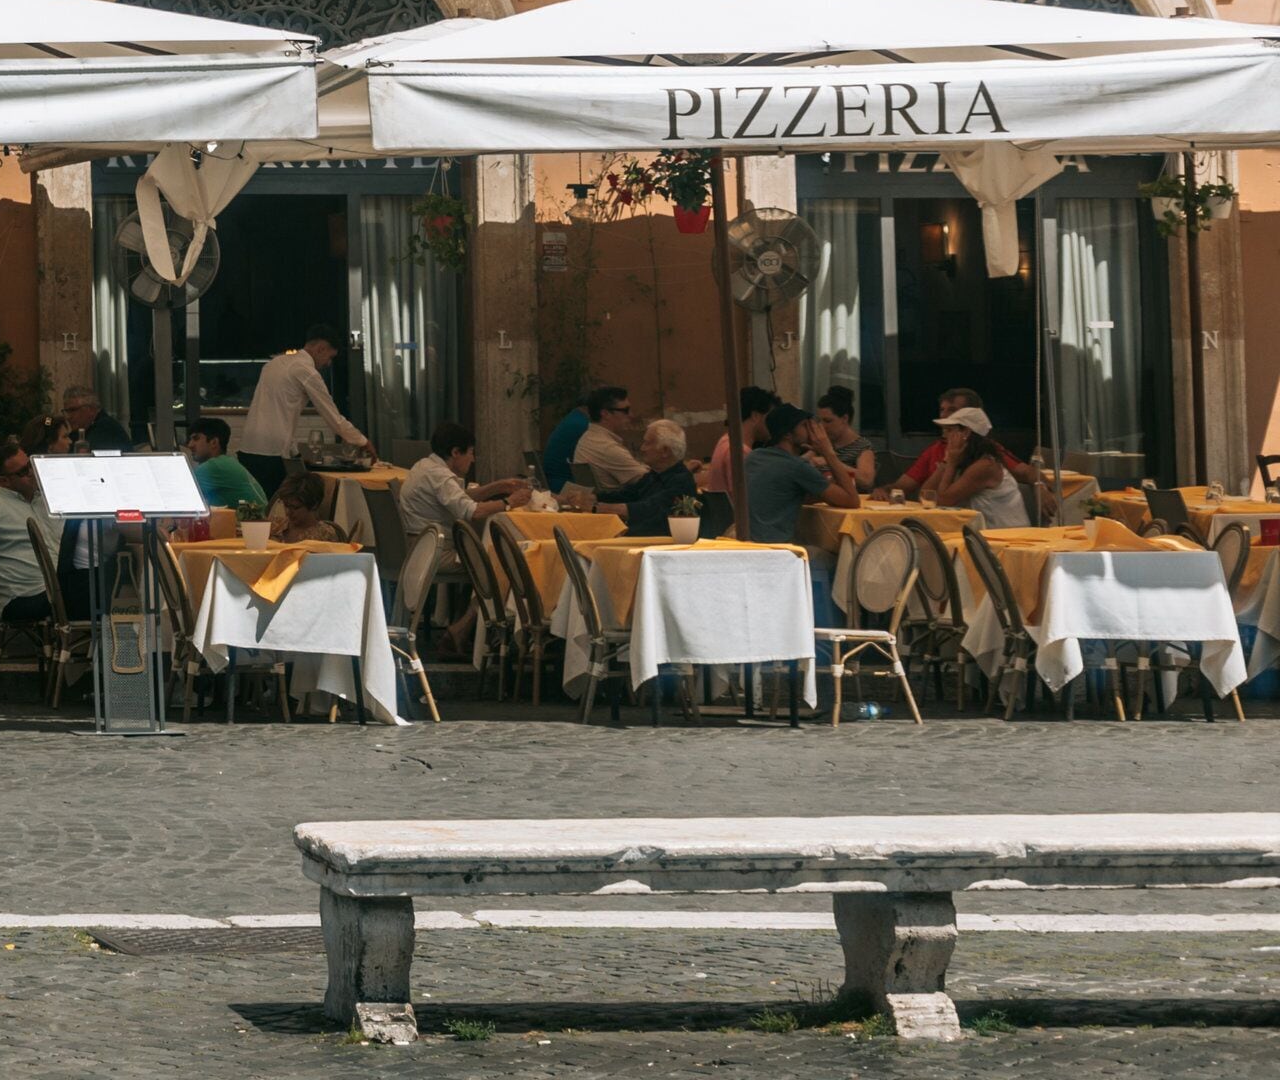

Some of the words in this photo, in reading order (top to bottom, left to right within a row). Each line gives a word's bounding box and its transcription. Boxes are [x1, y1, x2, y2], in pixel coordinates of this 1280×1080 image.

[662, 80, 1009, 141] PIZZERIA
[62, 332, 79, 351] H
[497, 330, 513, 349] L
[780, 331, 795, 350] J
[1201, 330, 1219, 350] N
